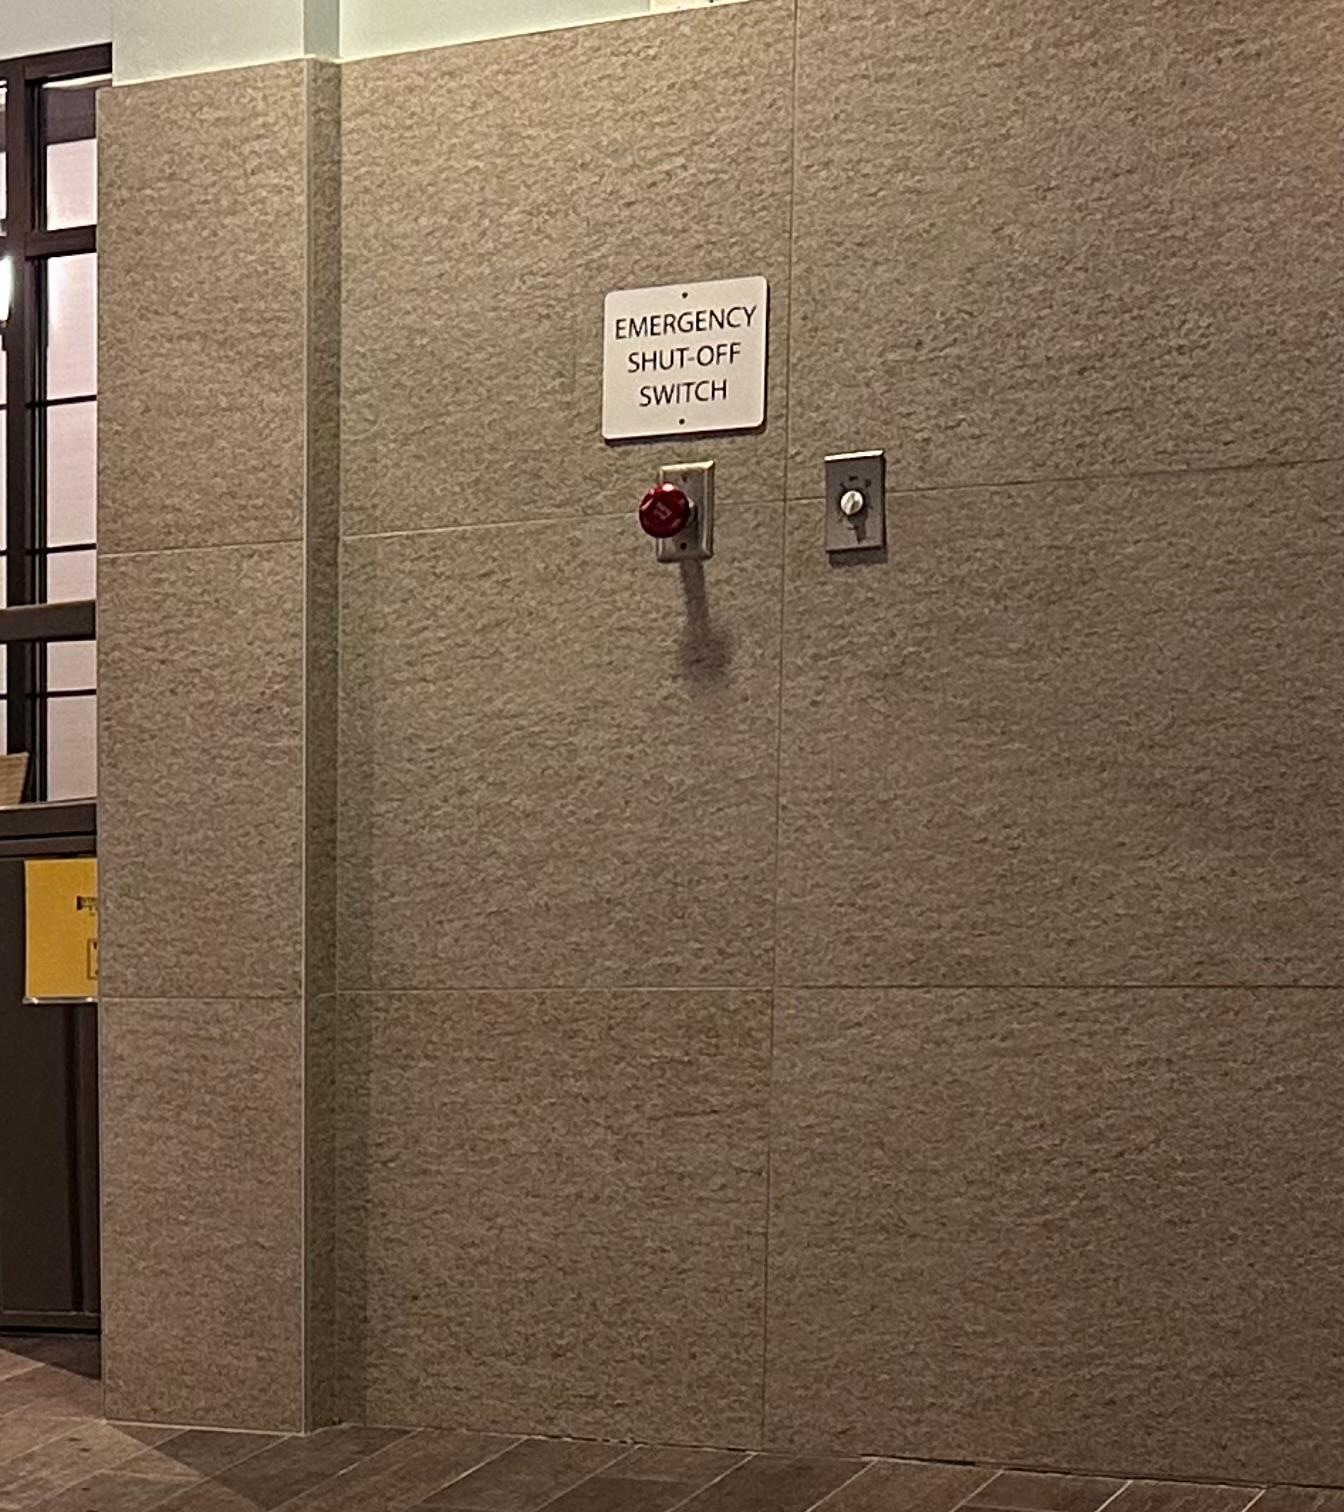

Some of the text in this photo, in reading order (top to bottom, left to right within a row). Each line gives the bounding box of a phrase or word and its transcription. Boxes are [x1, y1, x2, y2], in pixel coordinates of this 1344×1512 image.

[614, 305, 758, 340] EMERGENCY
[627, 342, 742, 373] SHUT-OFF
[638, 380, 728, 407] SWITCH
